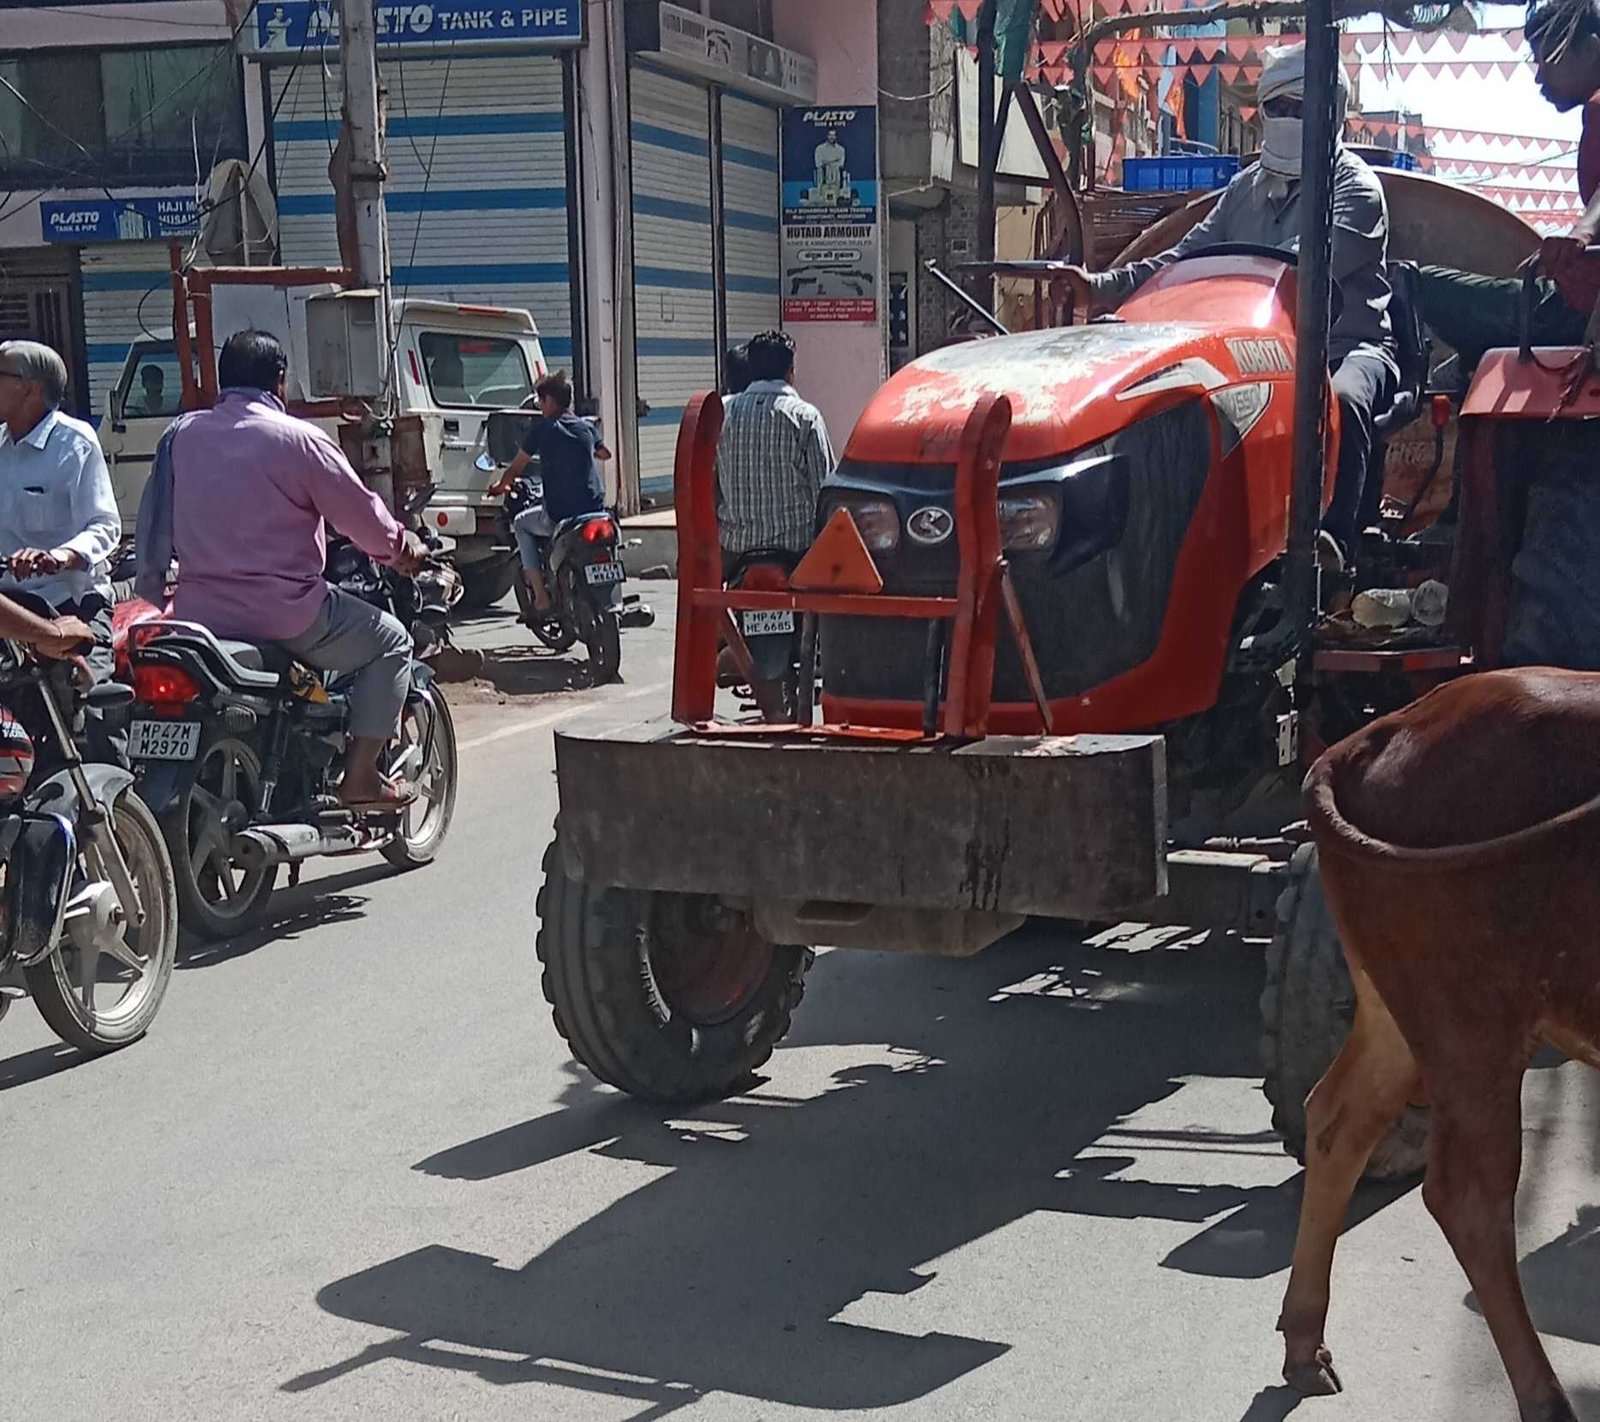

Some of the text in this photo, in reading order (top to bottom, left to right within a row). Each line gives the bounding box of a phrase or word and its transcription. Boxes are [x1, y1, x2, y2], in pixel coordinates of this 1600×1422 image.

[306, 4, 567, 38] PLSTO TANK & PIPE
[803, 111, 855, 121] PLASTO
[158, 201, 183, 213] HAJI
[51, 211, 100, 225] PLASTO
[82, 224, 97, 232] PIPE
[787, 226, 872, 239] HUTAIB ARMOURY
[1230, 339, 1293, 372] KUBOTA
